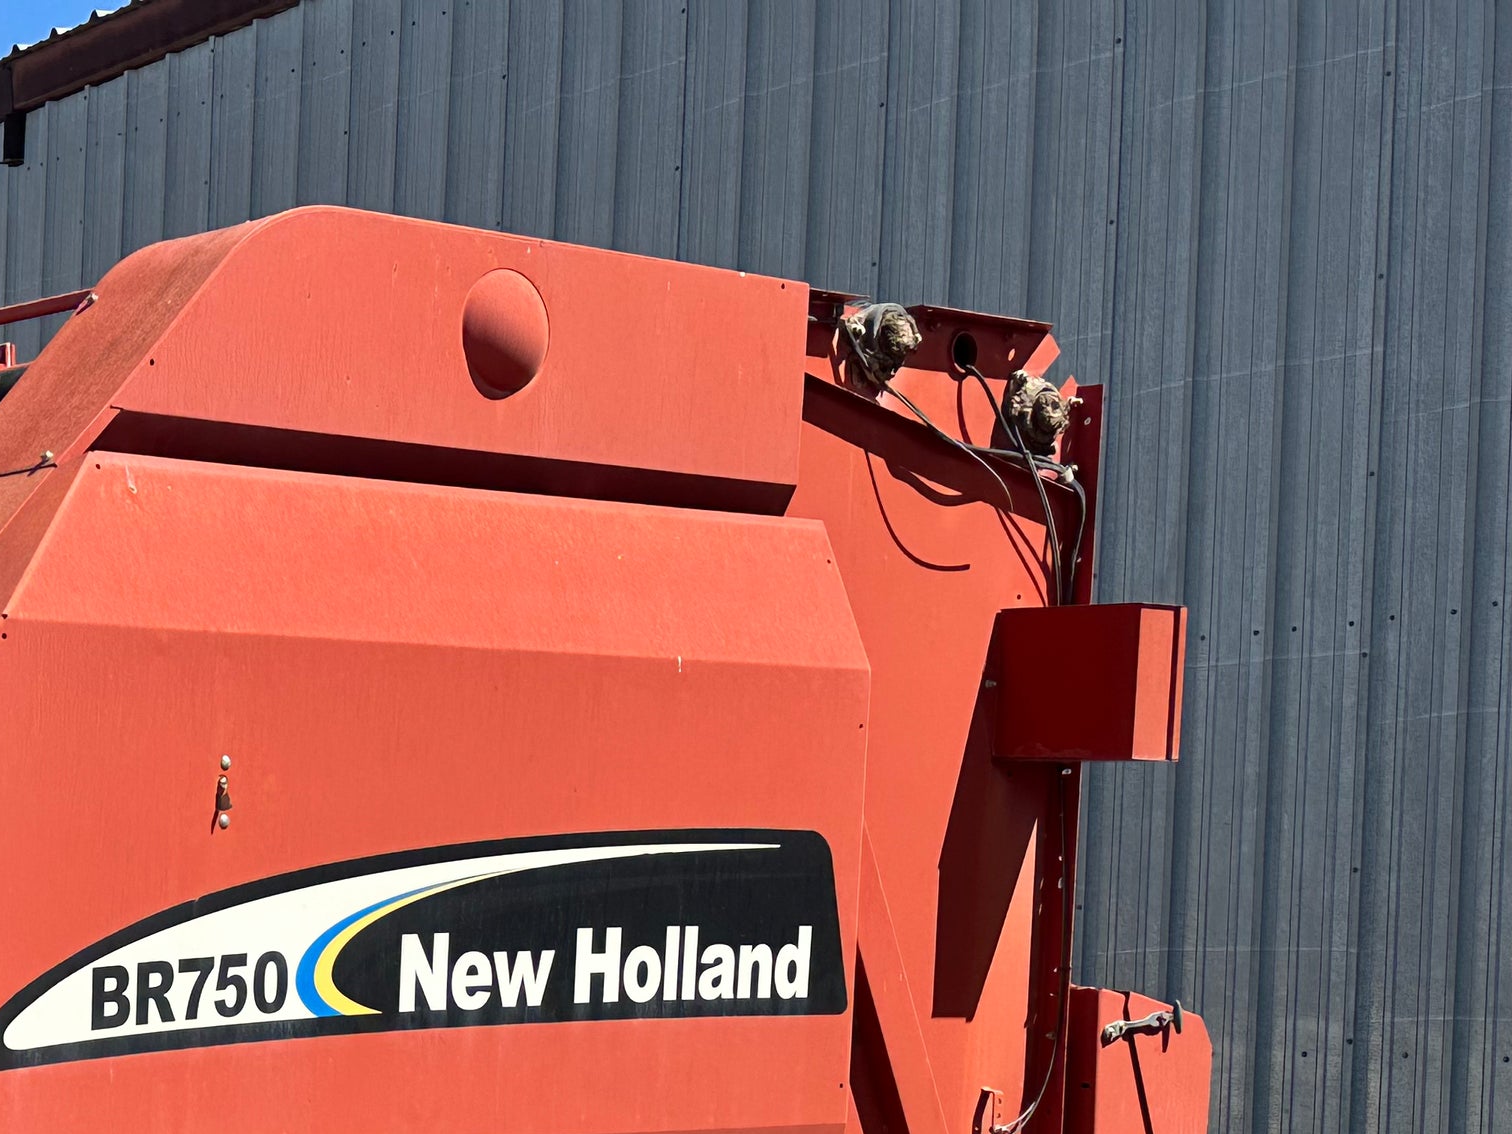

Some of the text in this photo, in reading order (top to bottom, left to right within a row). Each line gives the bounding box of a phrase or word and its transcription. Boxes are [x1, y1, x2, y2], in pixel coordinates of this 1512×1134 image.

[91, 951, 288, 1031] BR750
[399, 925, 813, 1012] New Holland
